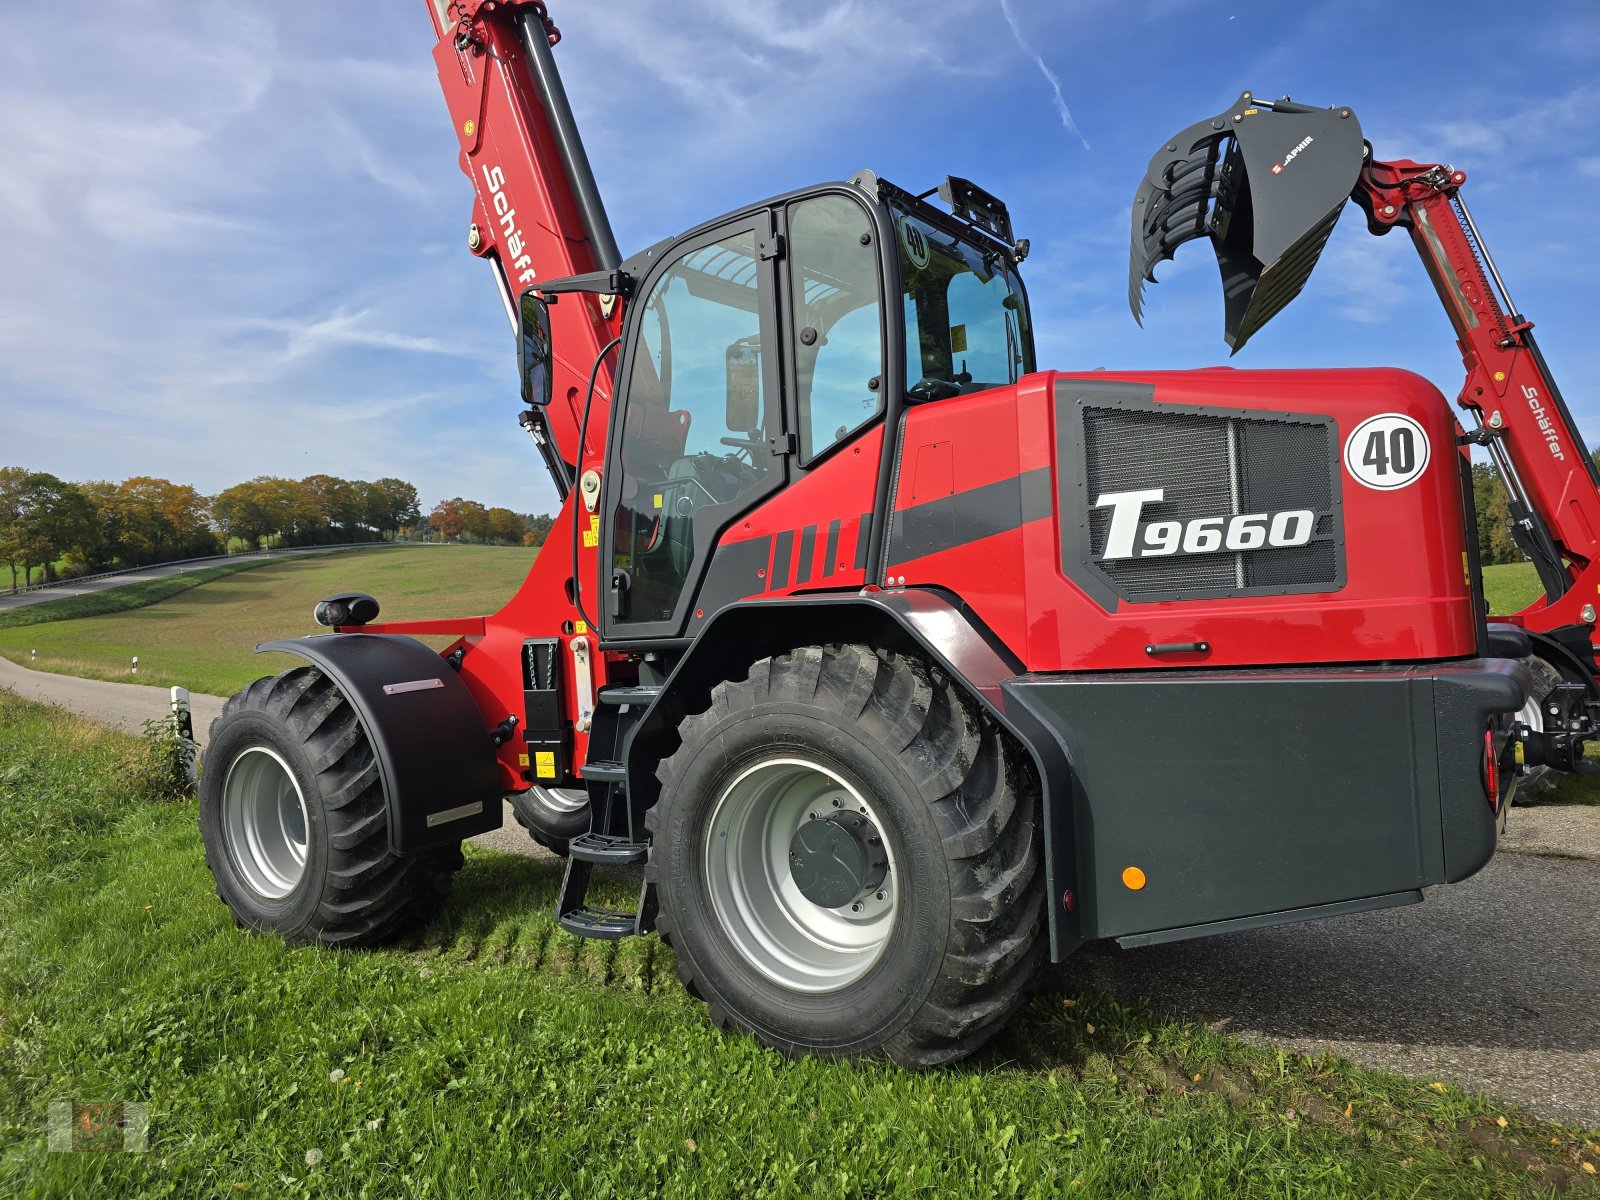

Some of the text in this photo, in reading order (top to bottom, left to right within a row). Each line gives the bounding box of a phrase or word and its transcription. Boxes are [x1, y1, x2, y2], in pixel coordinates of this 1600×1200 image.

[482, 164, 538, 298] Schäff
[905, 222, 925, 259] 40
[1362, 427, 1416, 476] 40
[1521, 385, 1565, 461] Schäffer
[1096, 489, 1314, 560] T9660
